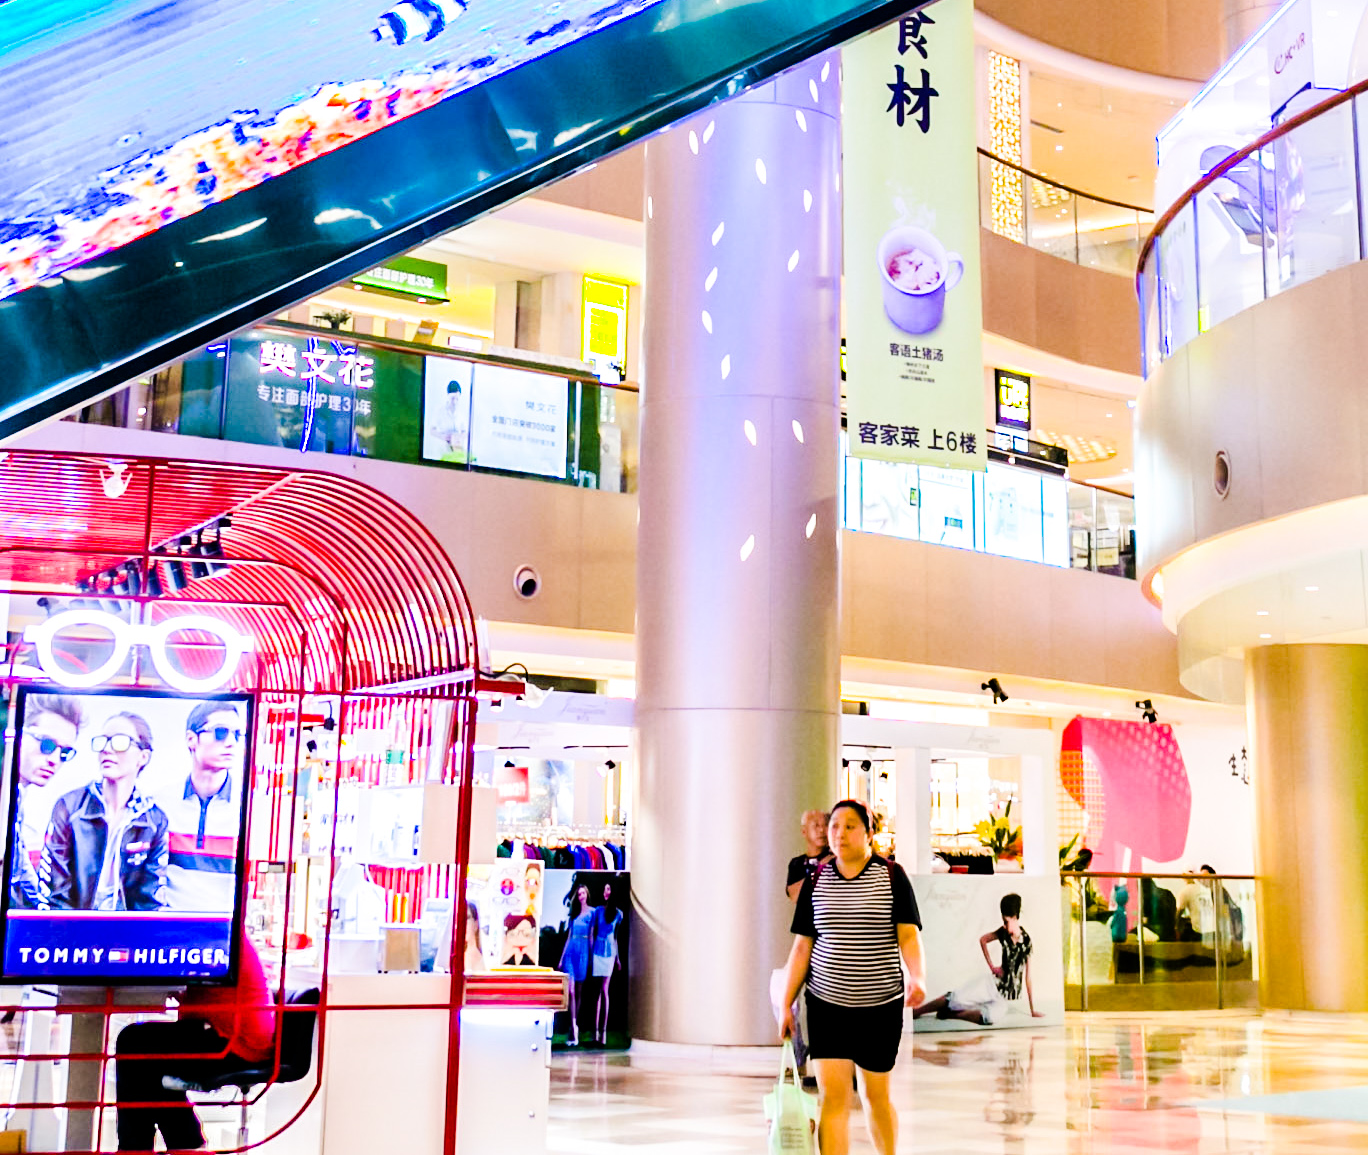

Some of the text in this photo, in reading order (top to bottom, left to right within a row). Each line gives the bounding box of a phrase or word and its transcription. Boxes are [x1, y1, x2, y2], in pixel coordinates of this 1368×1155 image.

[259, 340, 374, 388] 樊文花
[889, 343, 944, 362] 客语土猪汤
[858, 422, 977, 455] 客家菜 上6楼
[19, 947, 226, 965] TOMMY HILFIGER
